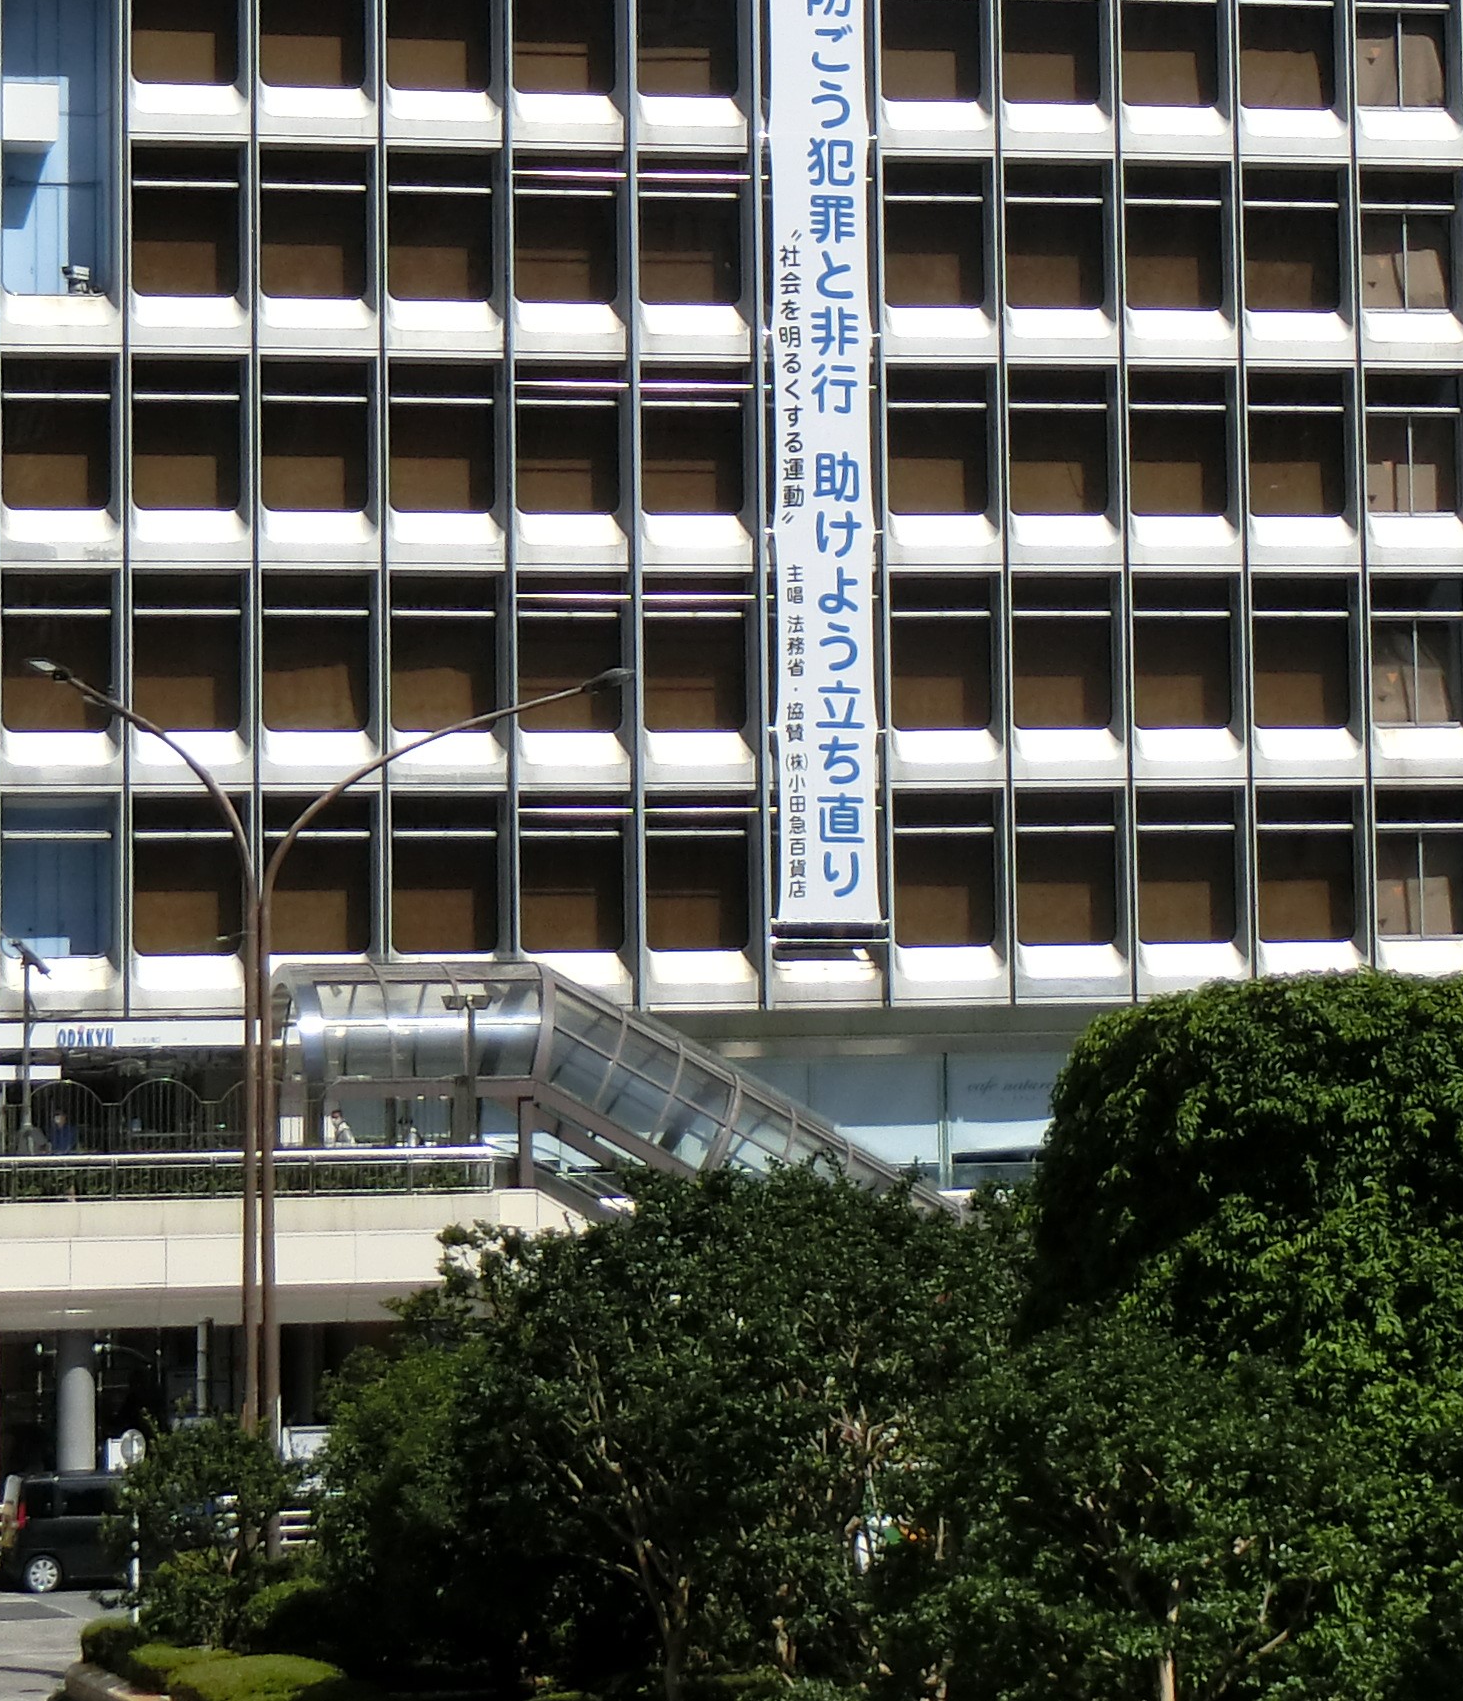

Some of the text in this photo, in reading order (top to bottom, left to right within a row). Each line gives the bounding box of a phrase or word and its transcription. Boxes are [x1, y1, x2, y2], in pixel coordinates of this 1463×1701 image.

[812, 450, 865, 898] 助けよう立ち直り
[56, 1024, 115, 1048] ODAKYU
